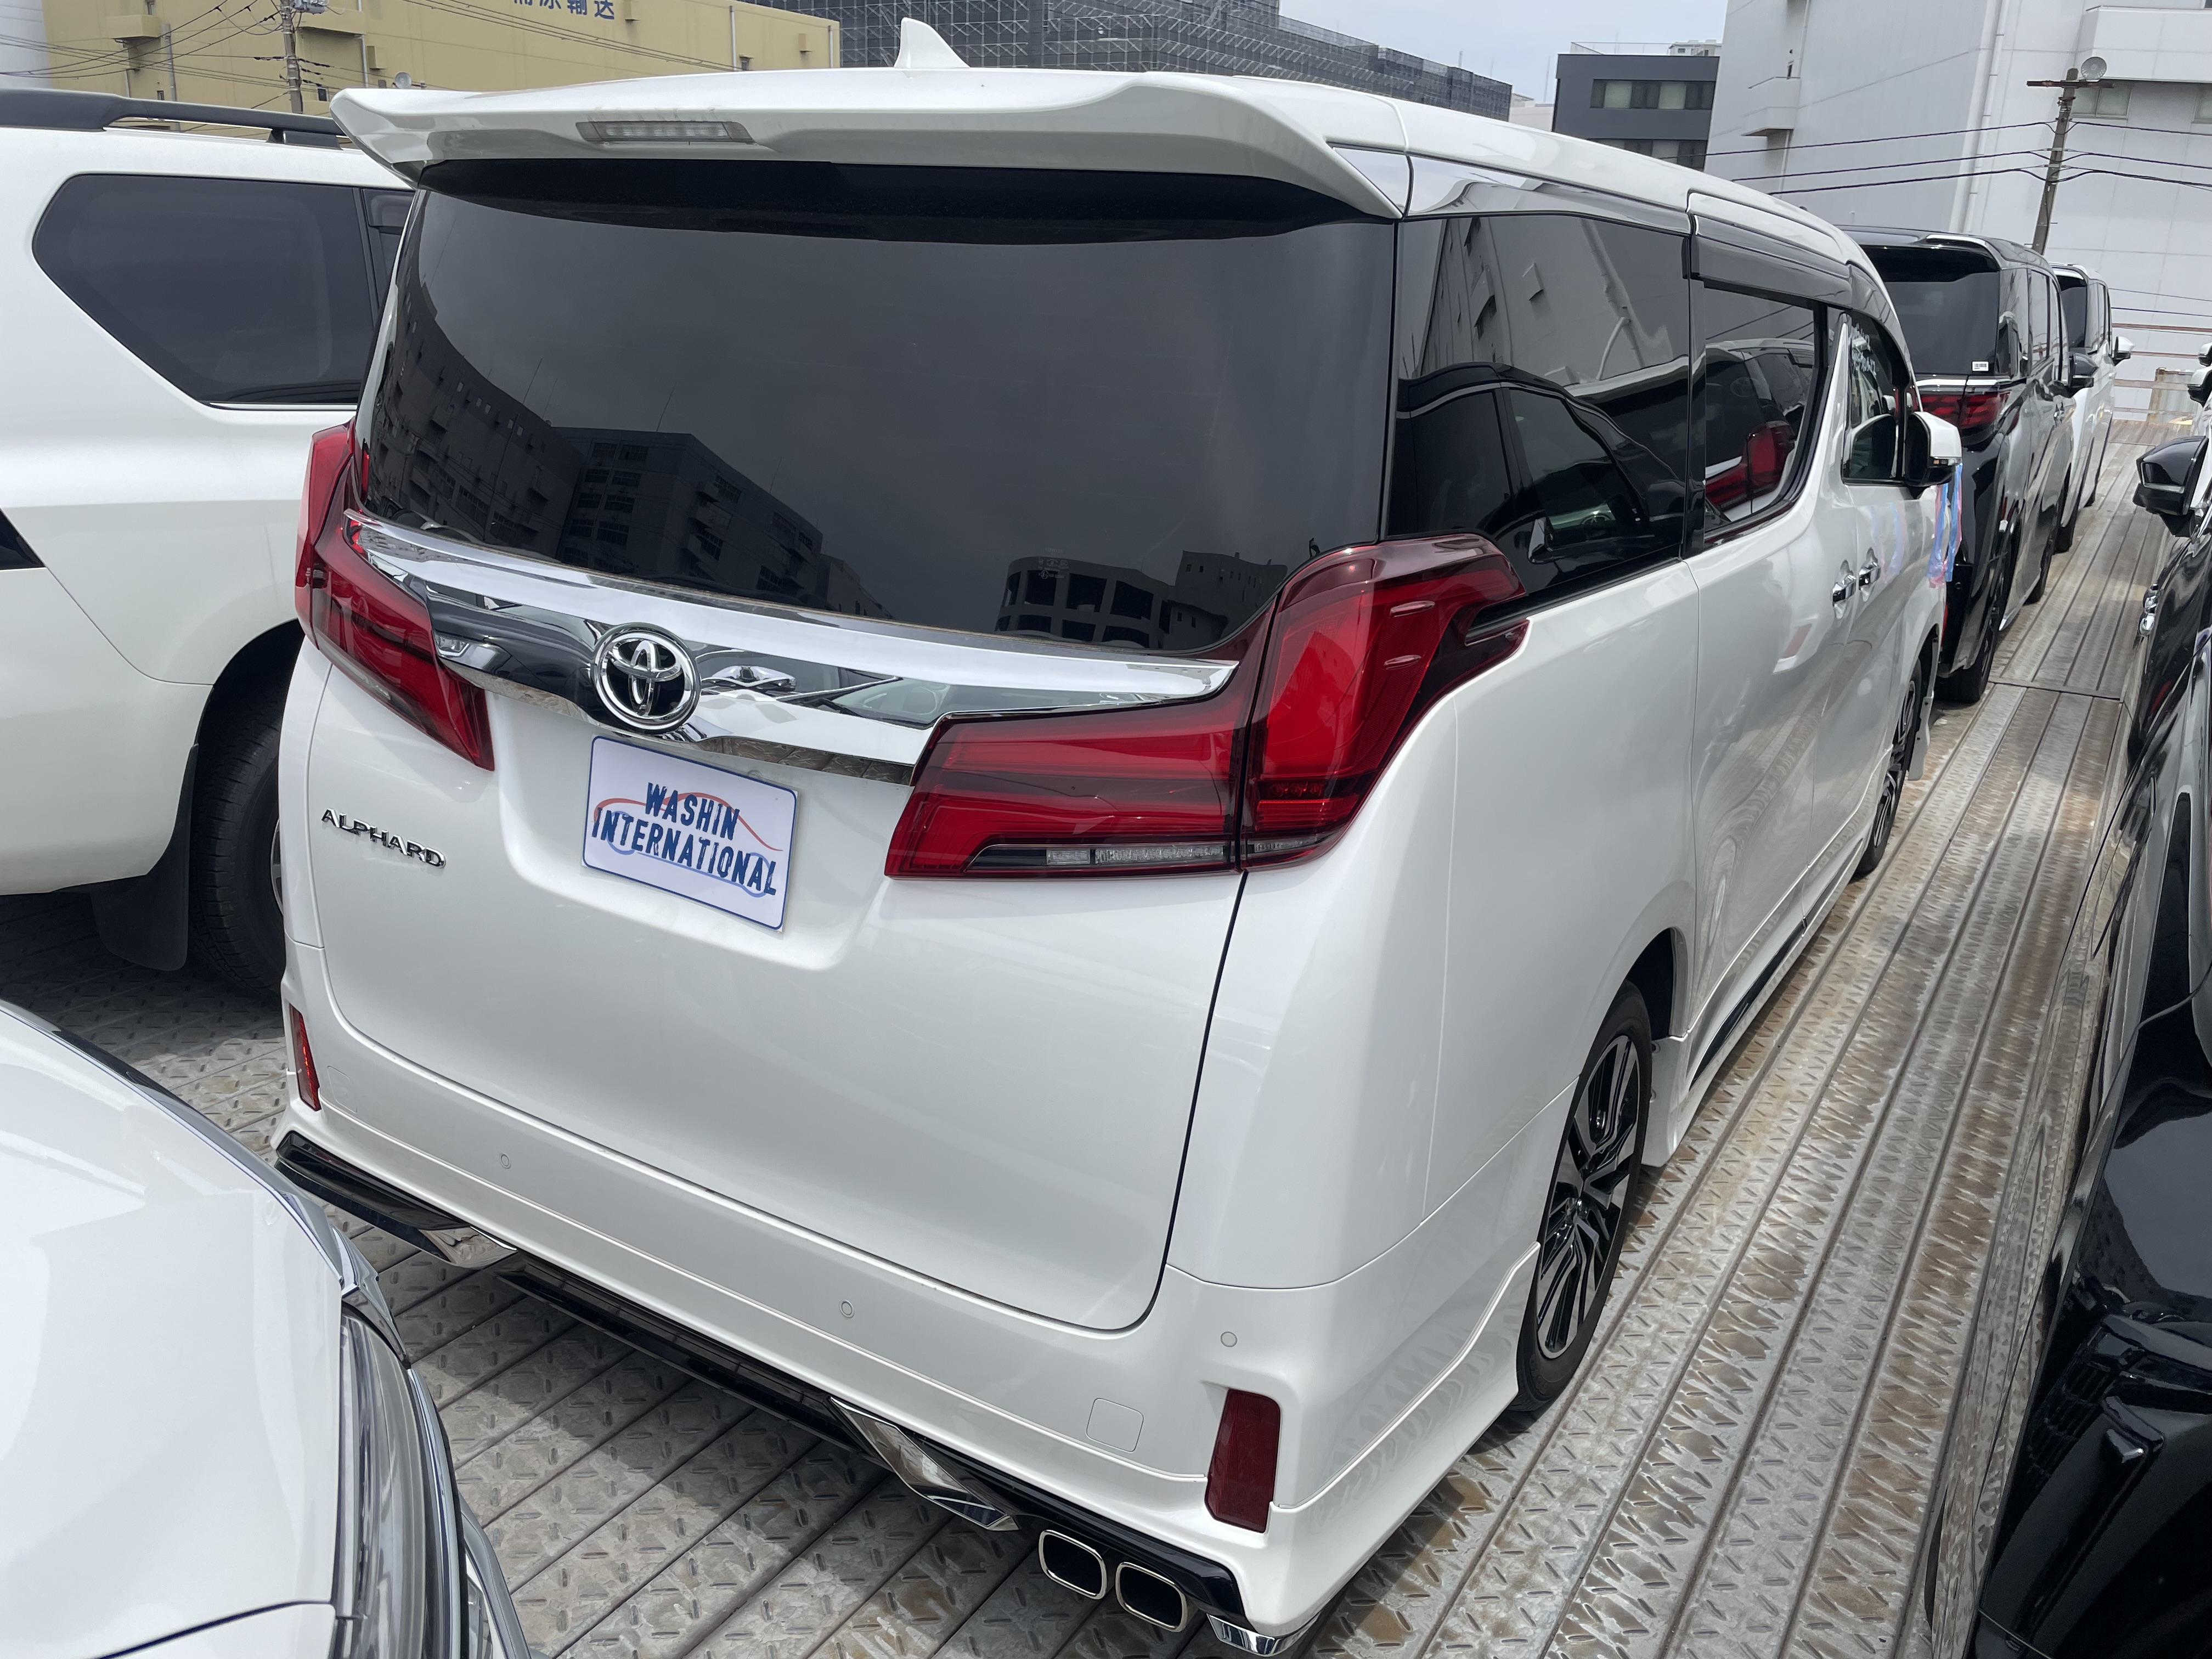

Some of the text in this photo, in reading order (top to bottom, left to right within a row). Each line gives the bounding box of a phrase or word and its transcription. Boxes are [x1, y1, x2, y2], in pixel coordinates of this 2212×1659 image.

[321, 808, 447, 868] ALPHARD
[645, 782, 740, 840] WASHIN
[591, 808, 776, 896] INTERNATIONAL
